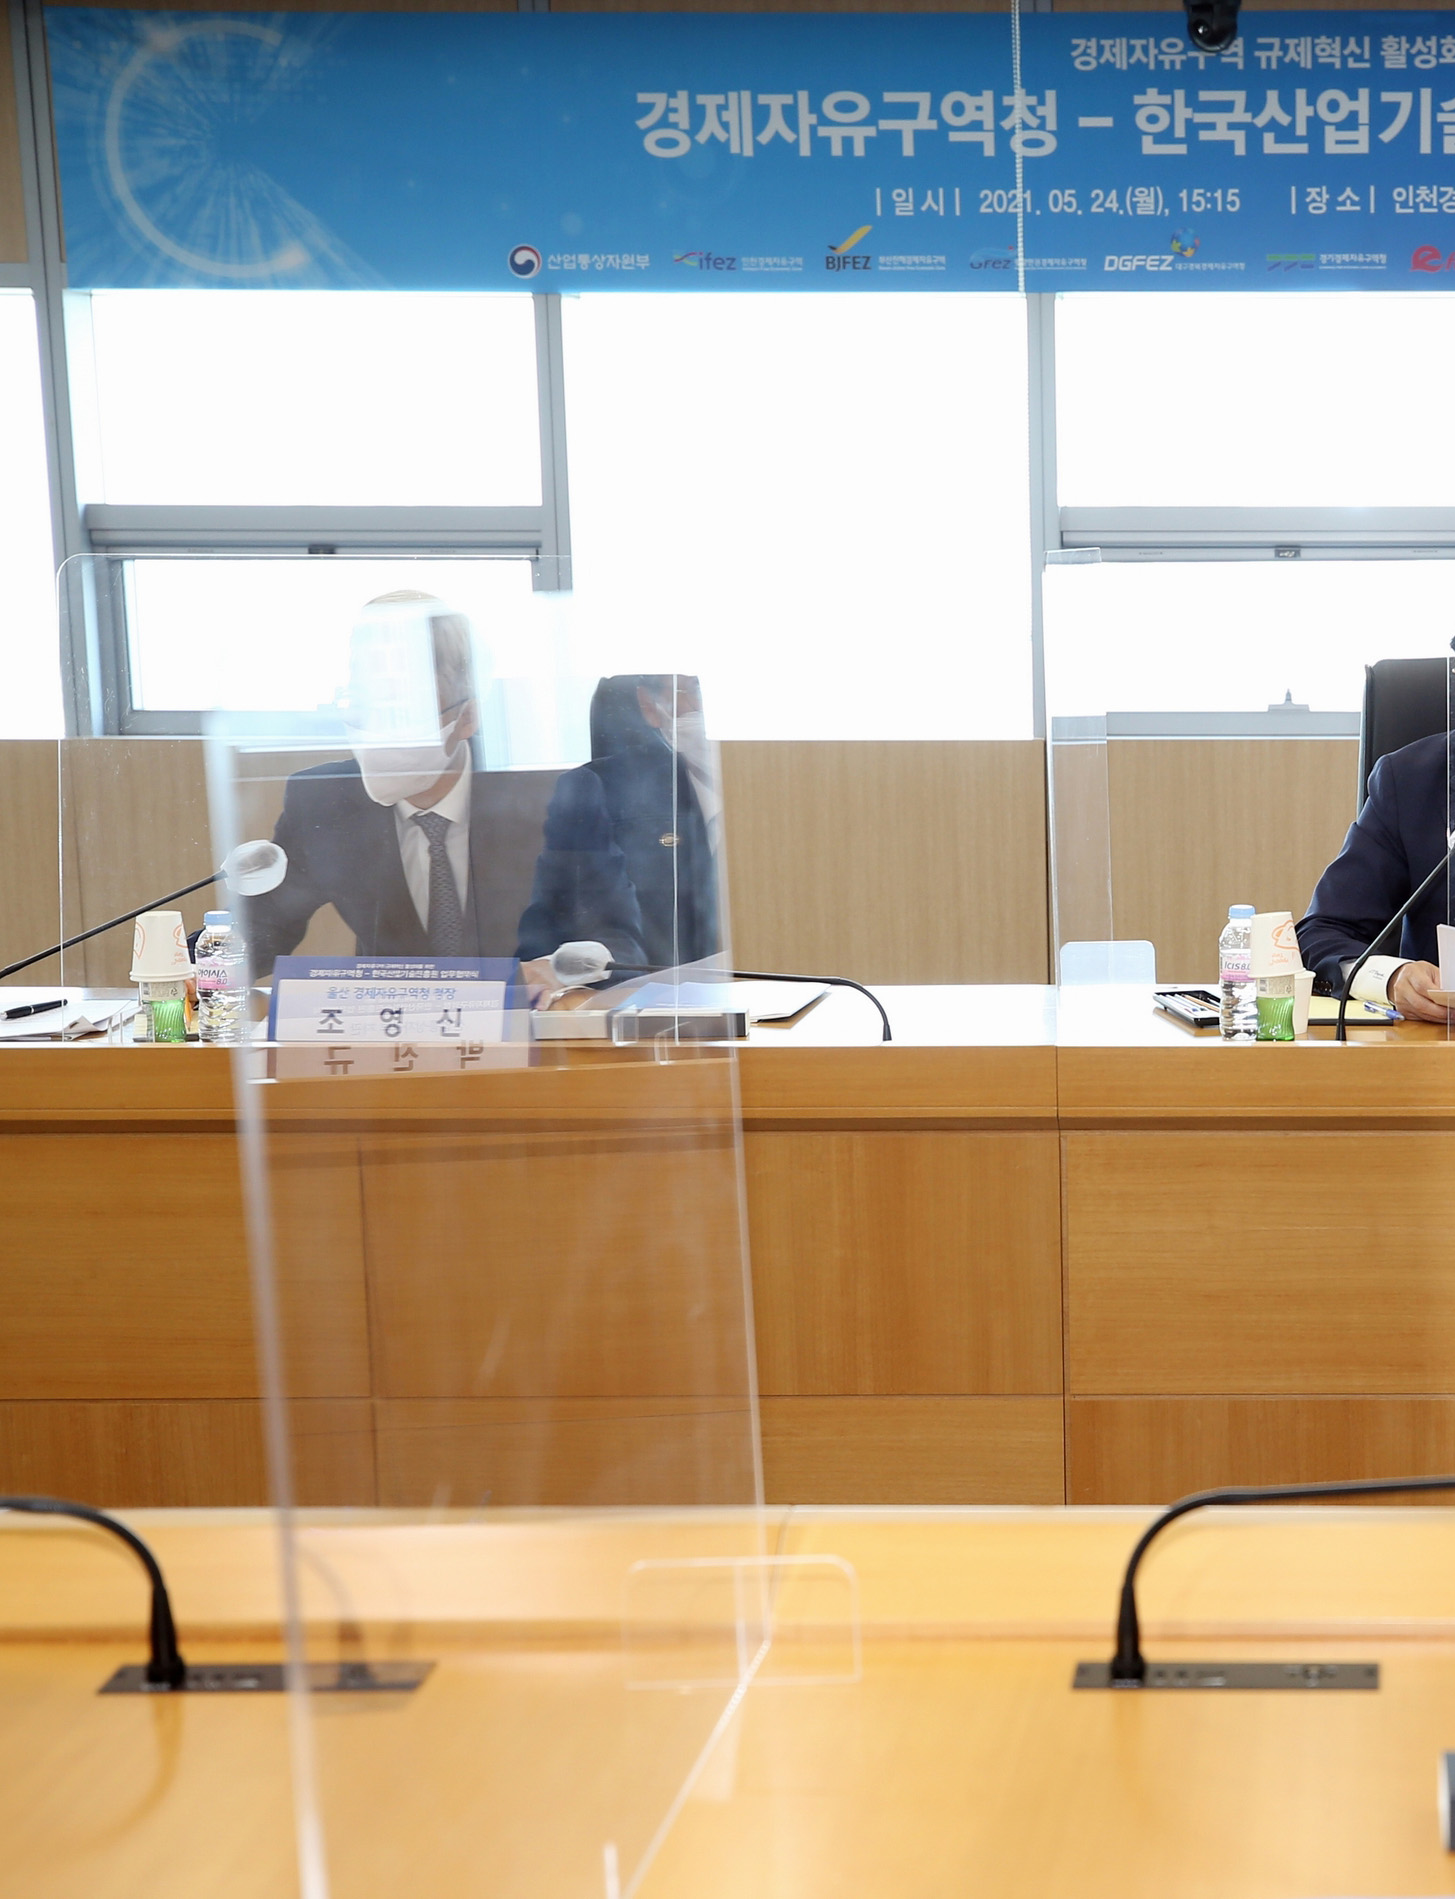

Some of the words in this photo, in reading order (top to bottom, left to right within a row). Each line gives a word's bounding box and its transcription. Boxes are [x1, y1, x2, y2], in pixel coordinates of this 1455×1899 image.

[1254, 36, 1370, 69] 규제혁신
[635, 88, 1058, 158] 경제자유구역청
[1048, 190, 1083, 215] 05.
[1178, 189, 1241, 213] 15:15
[547, 254, 651, 270] 산업통상자원부
[704, 251, 738, 271] ifez
[825, 255, 872, 272] BJFEZ
[1103, 255, 1174, 271] DGFEZ
[198, 969, 228, 978] 아이시스
[353, 987, 430, 1000] 경제자유구역청
